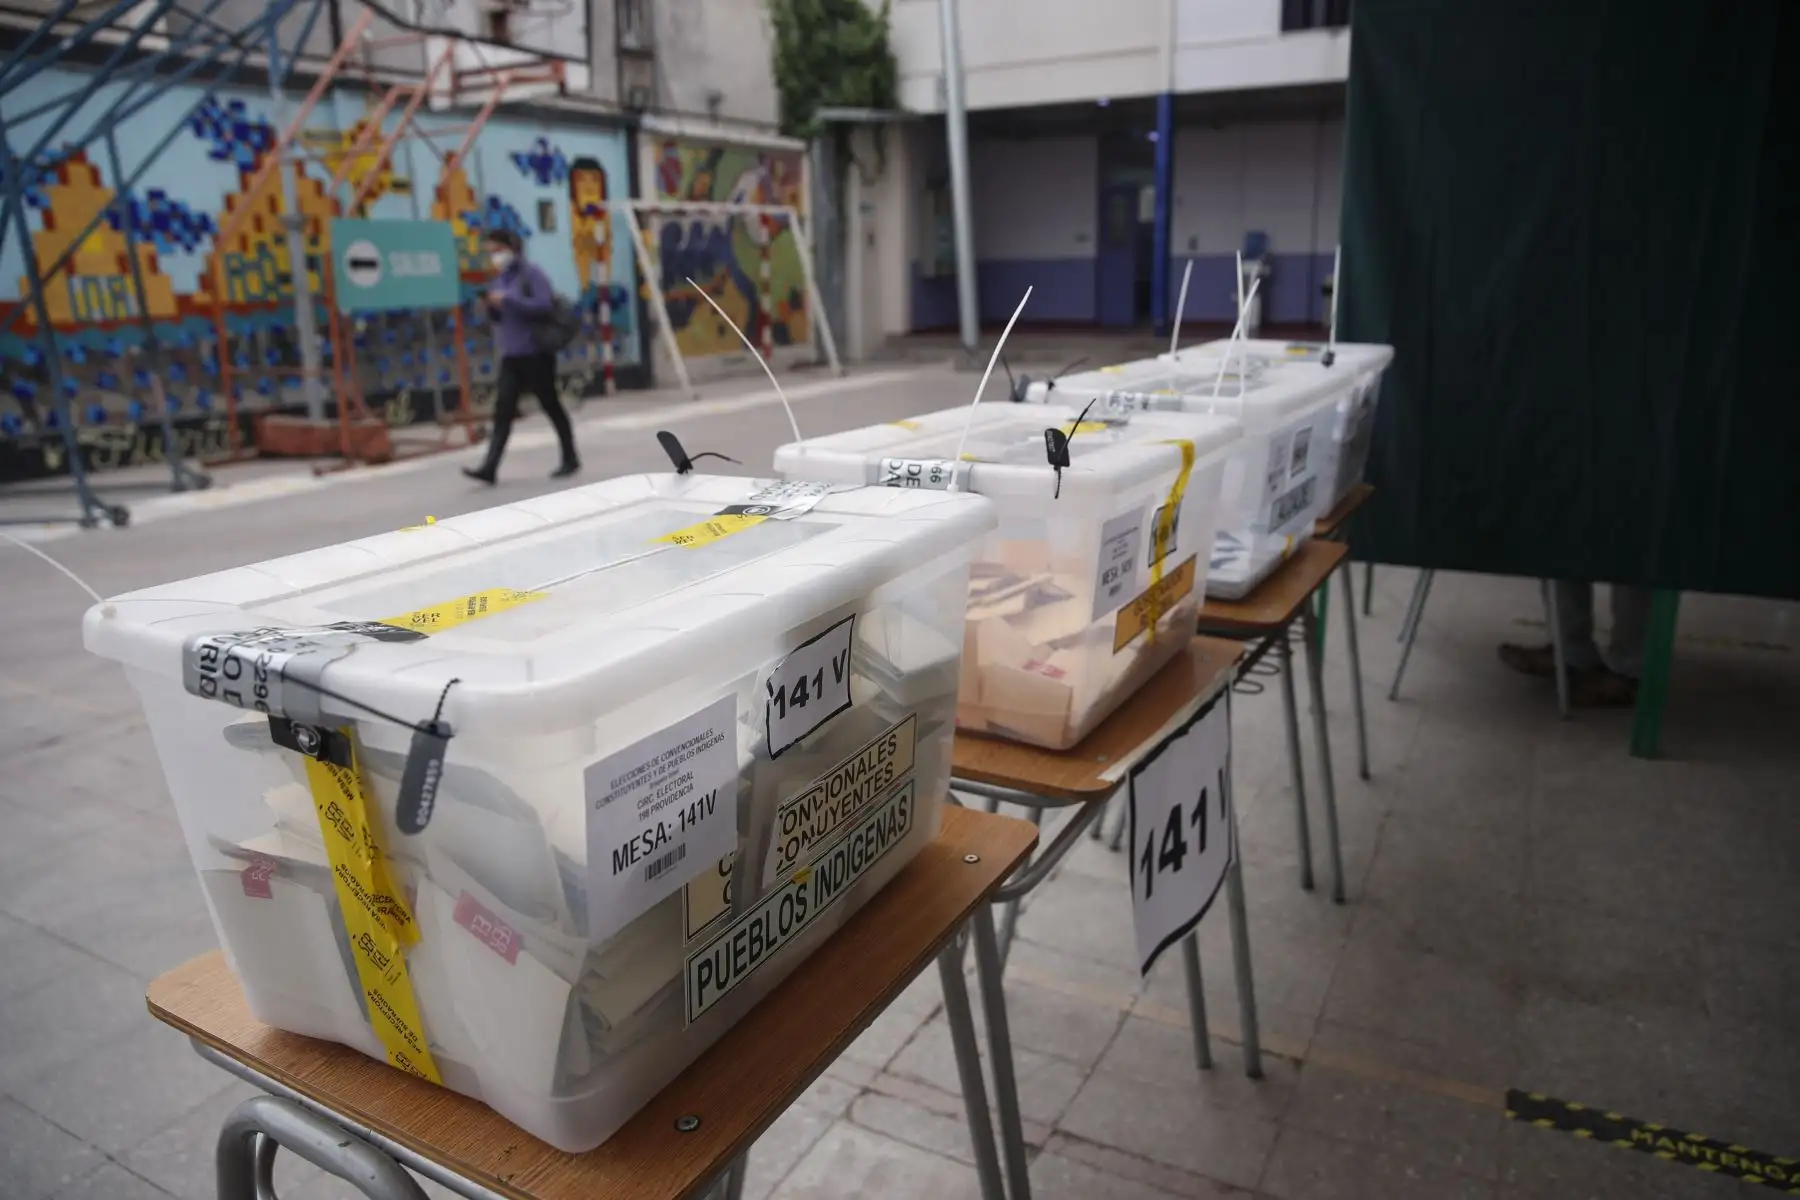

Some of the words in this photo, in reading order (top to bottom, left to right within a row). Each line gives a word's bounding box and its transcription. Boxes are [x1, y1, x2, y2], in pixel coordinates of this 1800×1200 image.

[774, 667, 823, 719] 141
[832, 648, 847, 684] V
[595, 770, 653, 810] CONSTITUYENTES
[667, 748, 696, 773] PUEBLOS
[610, 760, 652, 791] ELECCIONES
[651, 756, 660, 767] DE
[660, 728, 714, 762] CONVENCIONALES
[656, 771, 694, 799] ELECTORAL
[612, 822, 672, 876] MESA:
[678, 788, 717, 832] 141V
[650, 783, 694, 817] PROVIDENCIA
[1140, 785, 1207, 901] 141
[697, 882, 807, 1009] PUEBLOS
[813, 795, 908, 910] INDÍGENAS
